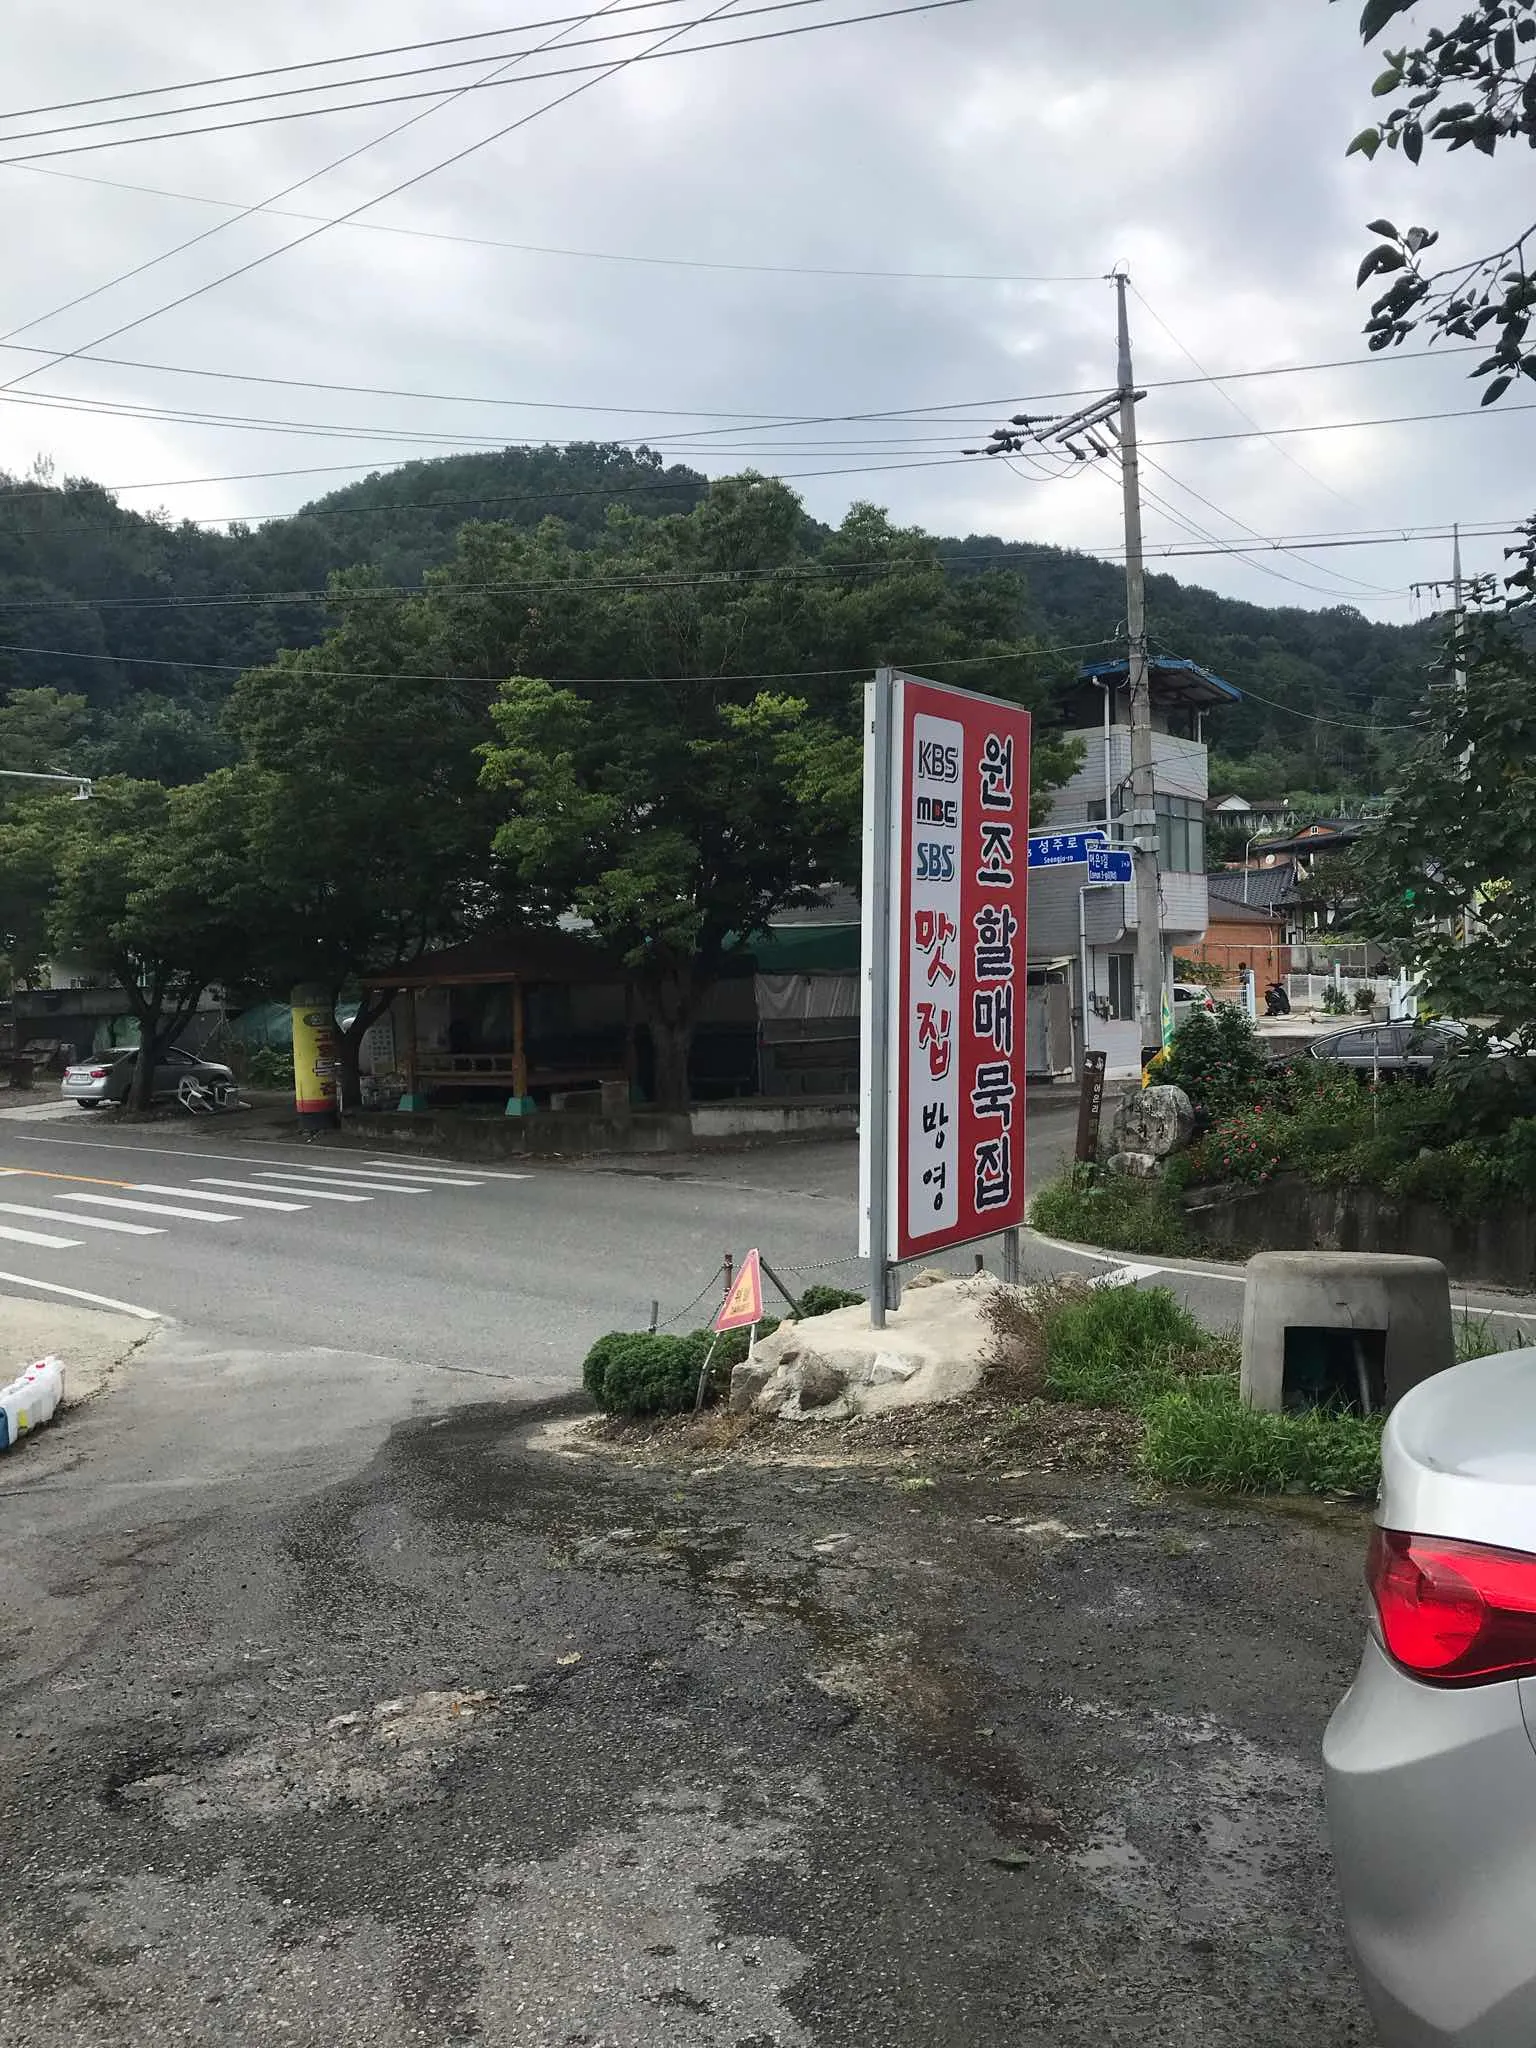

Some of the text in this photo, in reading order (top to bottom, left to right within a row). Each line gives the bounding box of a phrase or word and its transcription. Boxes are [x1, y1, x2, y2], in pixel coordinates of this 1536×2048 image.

[917, 739, 959, 781] KBS
[916, 841, 956, 882] SBS
[1038, 836, 1078, 854] 성주로
